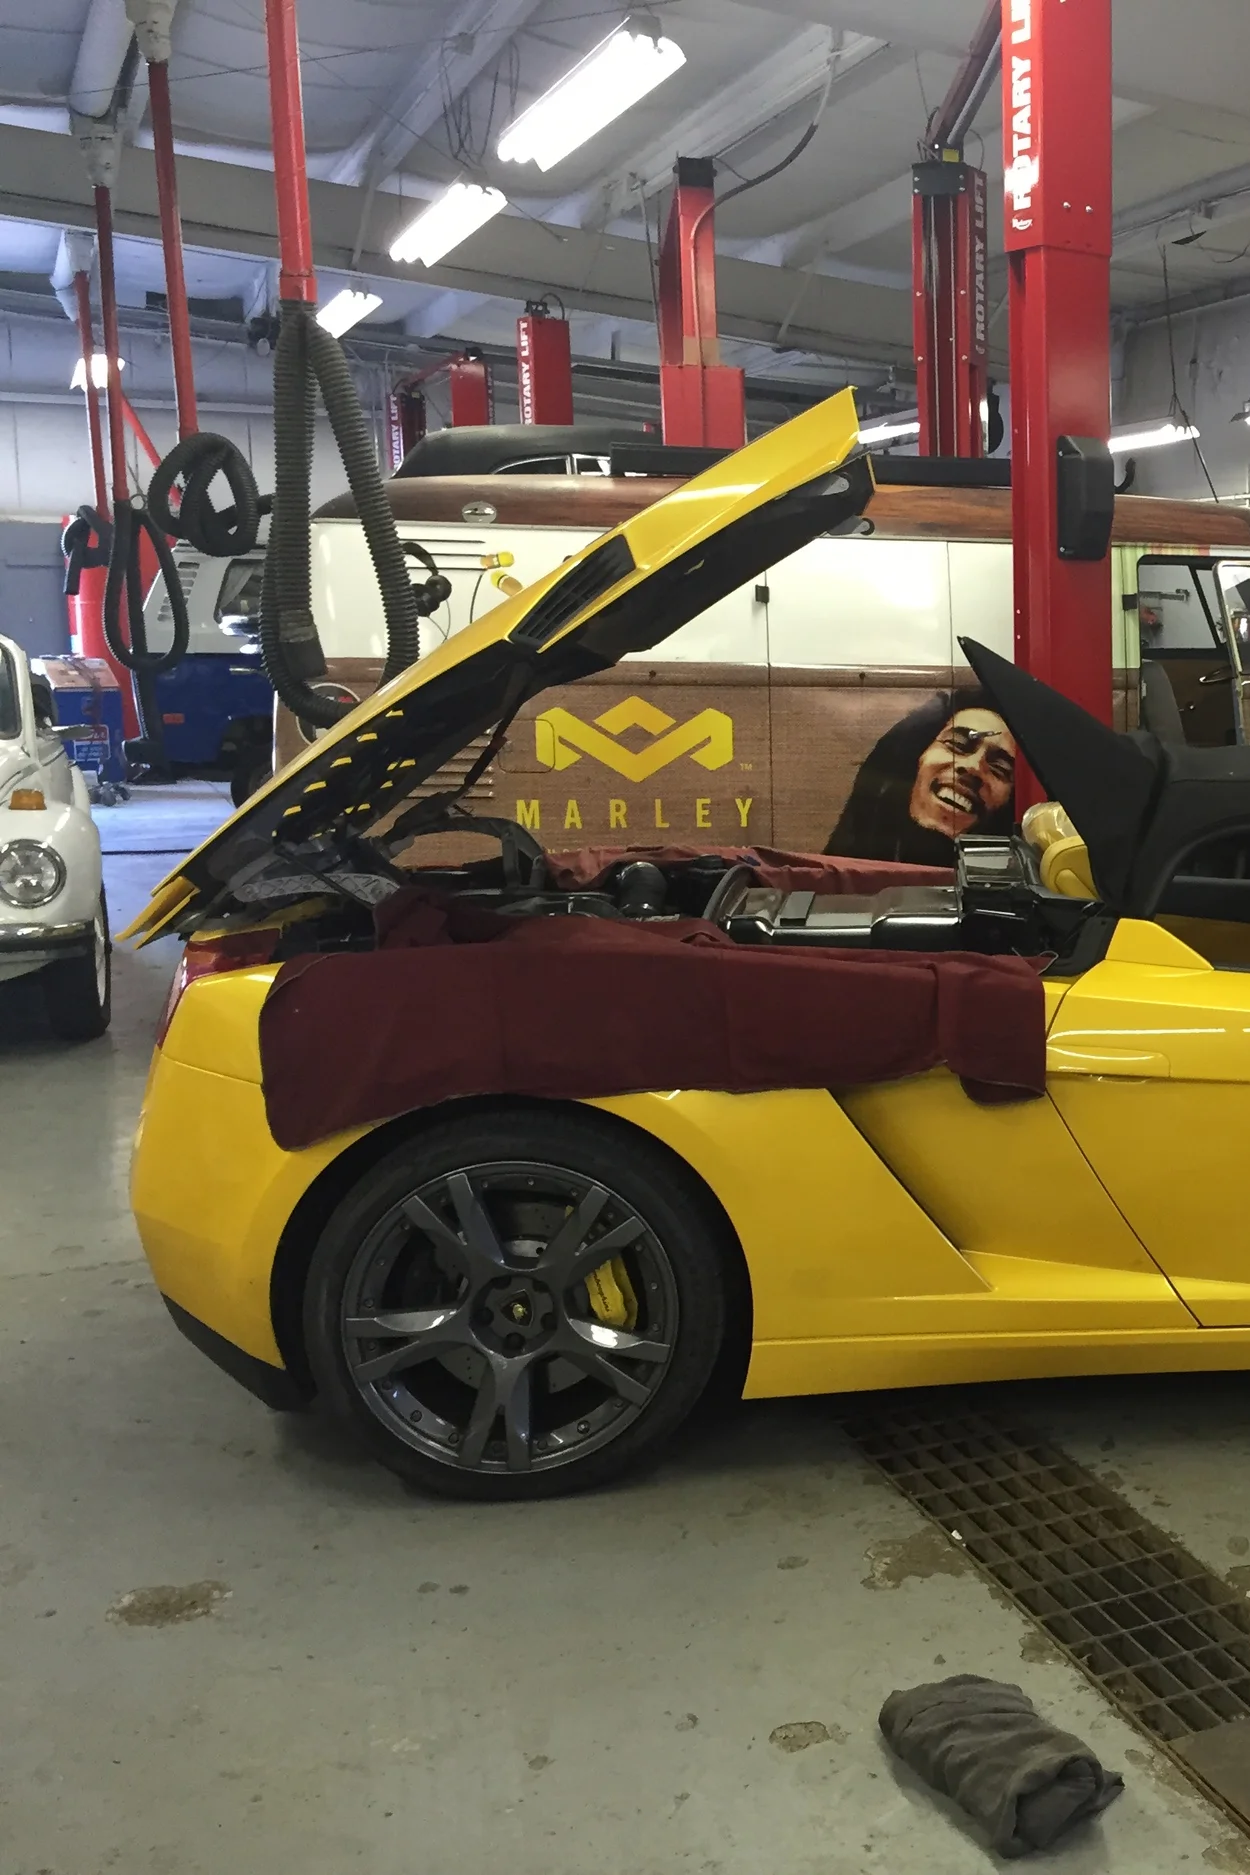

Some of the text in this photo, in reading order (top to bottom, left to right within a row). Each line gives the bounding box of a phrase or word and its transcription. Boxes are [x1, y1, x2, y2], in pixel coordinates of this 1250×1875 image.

[973, 170, 986, 341] ROTARY LIFT
[519, 320, 531, 357] LIFT
[389, 394, 399, 422] LIFT
[515, 797, 753, 830] MARLEY
